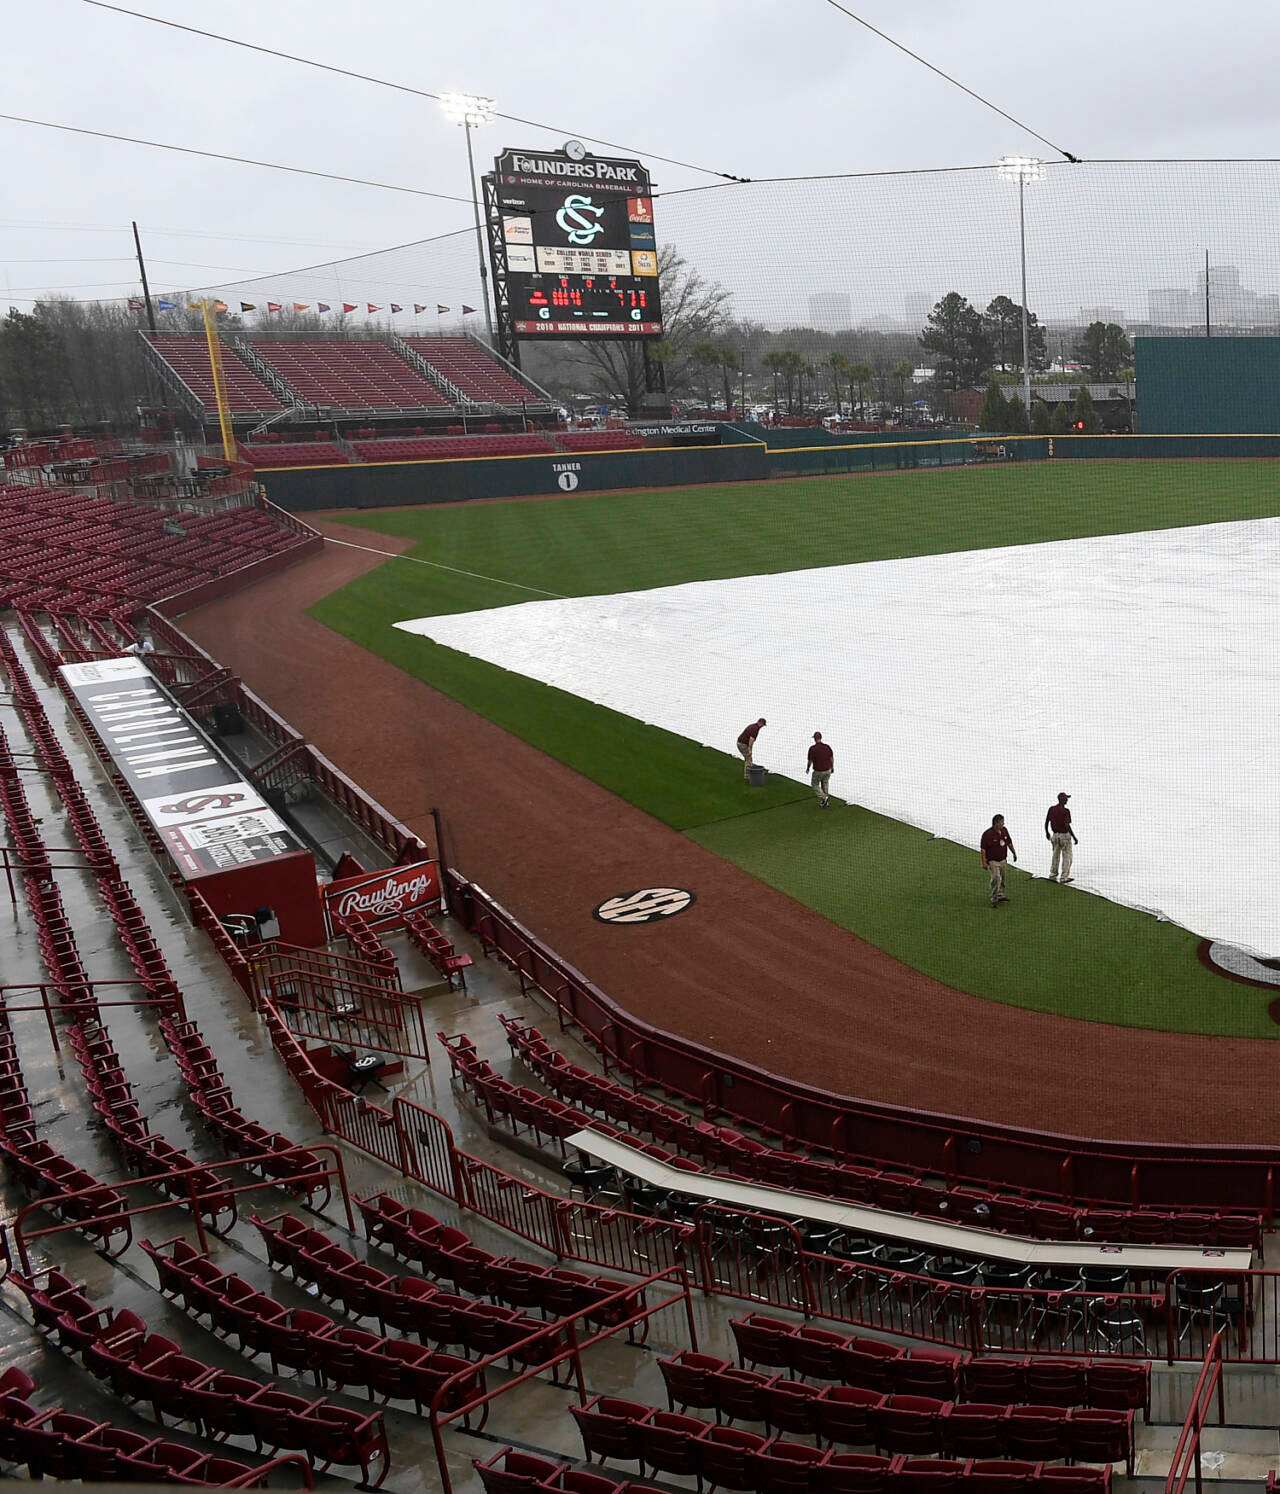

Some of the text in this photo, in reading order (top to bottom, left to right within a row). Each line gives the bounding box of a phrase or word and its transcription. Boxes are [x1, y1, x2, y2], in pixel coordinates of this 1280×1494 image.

[512, 155, 638, 181] FOUNDERS PARK
[556, 181, 594, 189] CAROLINA
[596, 183, 632, 192] BASEBALL
[539, 308, 641, 320] G G
[536, 323, 644, 332] 2010 NATIONAL CHAMPIONS 2011
[661, 425, 690, 434] Medical
[692, 424, 716, 433] Center
[552, 463, 581, 471] TANNER
[88, 689, 218, 779] CAROLINA
[200, 824, 242, 846] BBQ
[339, 874, 432, 916] Rawlings
[598, 888, 691, 922] SEC
